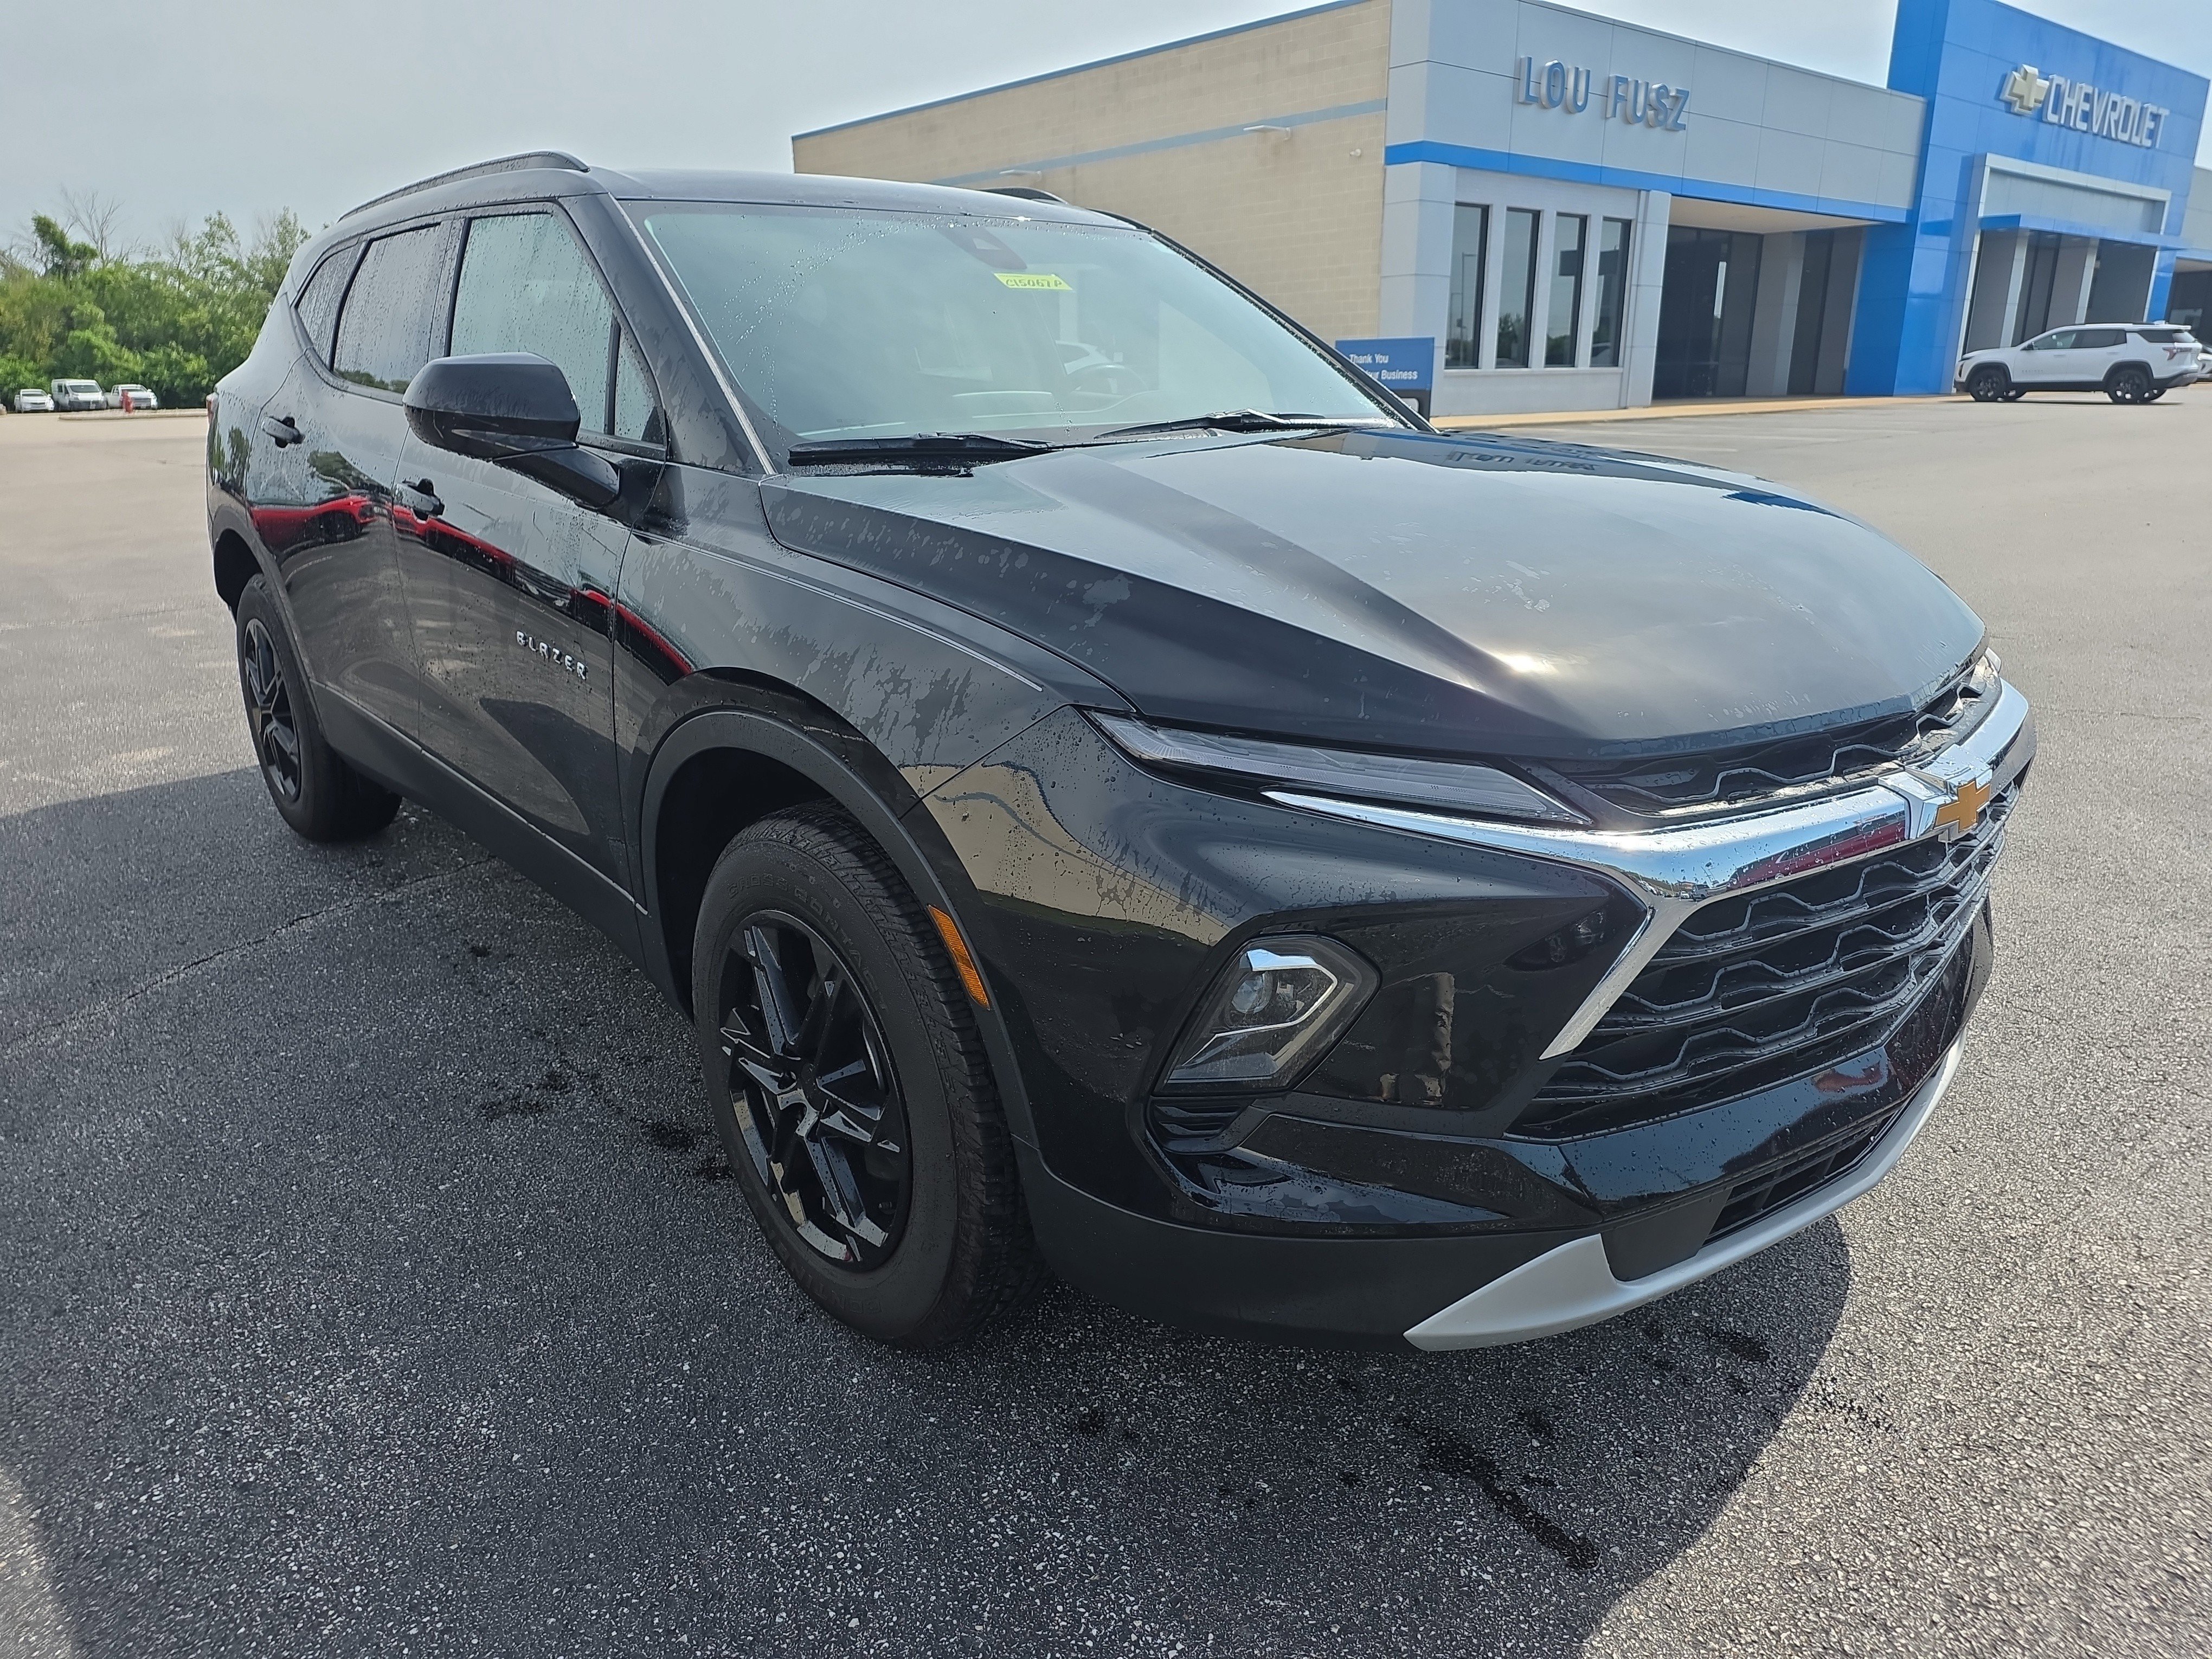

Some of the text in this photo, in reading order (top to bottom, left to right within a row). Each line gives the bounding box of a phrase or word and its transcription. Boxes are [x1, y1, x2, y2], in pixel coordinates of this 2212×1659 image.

[1519, 56, 1689, 131] LOU FUSZ
[2044, 74, 2170, 148] CHEVROLET
[1349, 353, 1389, 363] Thank You
[1381, 370, 1418, 380] Business
[516, 631, 587, 680] BLAZER
